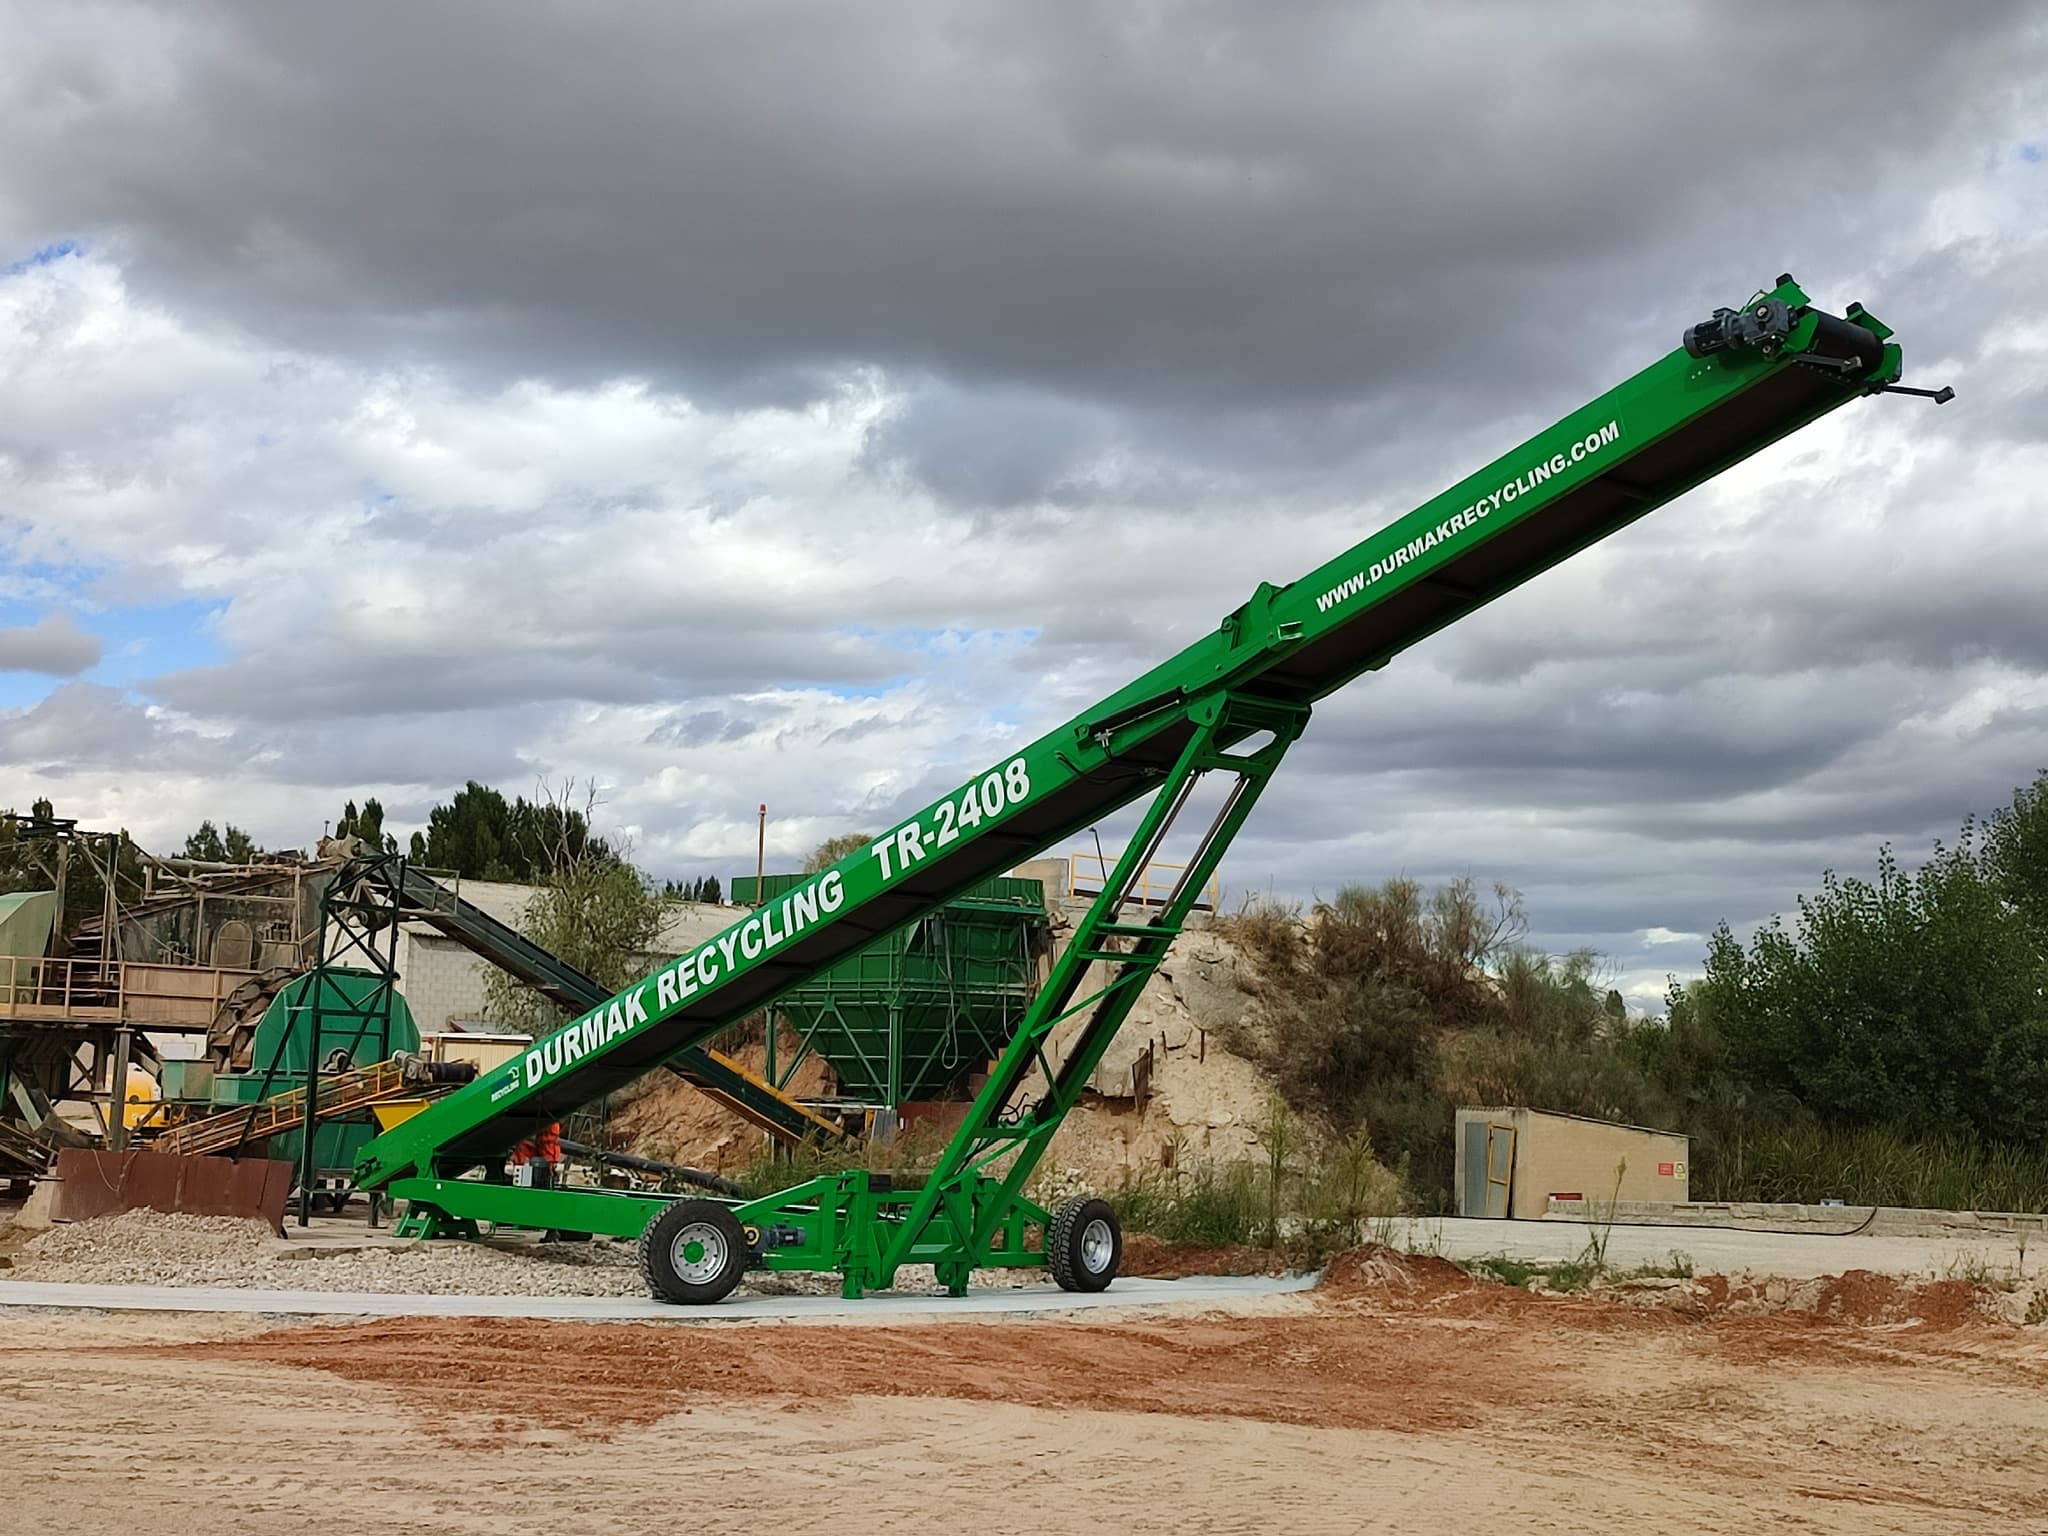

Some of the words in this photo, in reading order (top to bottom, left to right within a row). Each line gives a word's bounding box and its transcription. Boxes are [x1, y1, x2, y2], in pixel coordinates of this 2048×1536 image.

[1316, 420, 1620, 612] WWW.DURMAKRECYCLING.COM
[525, 985, 648, 1088] DURMAK
[657, 870, 844, 1011] RECYCLING
[871, 757, 1030, 881] TR-2408
